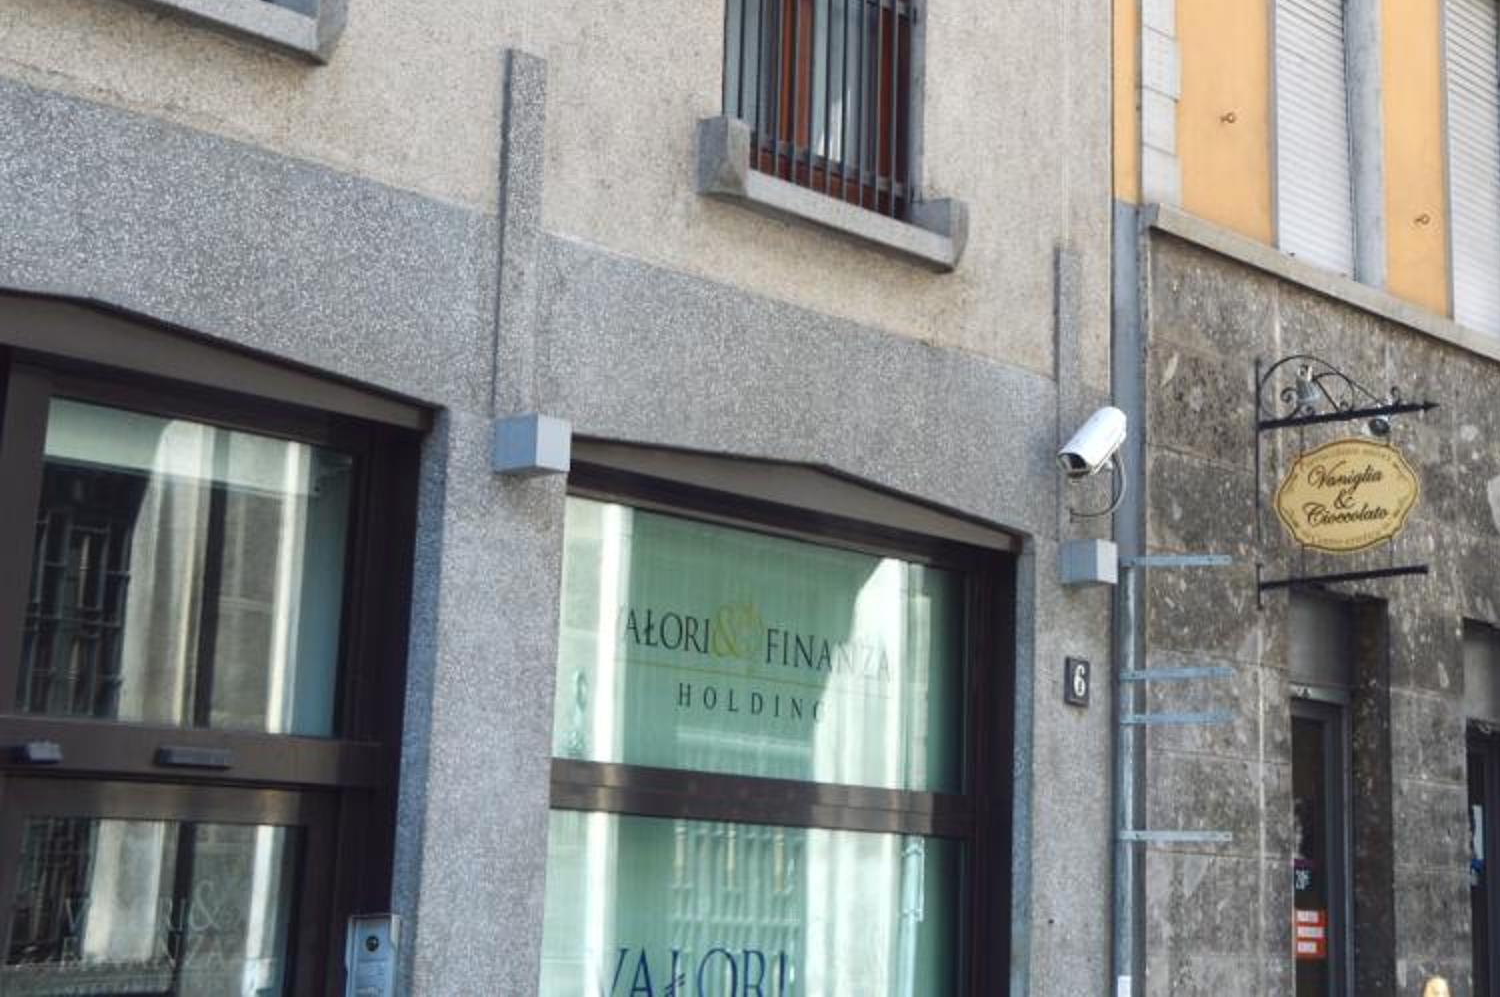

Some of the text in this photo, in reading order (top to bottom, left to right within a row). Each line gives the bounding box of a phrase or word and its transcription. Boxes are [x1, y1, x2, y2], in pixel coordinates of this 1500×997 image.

[1307, 460, 1382, 492] Vaniglia
[1333, 489, 1356, 510] &
[1302, 501, 1389, 528] Cioccolato
[1073, 664, 1087, 698] 6
